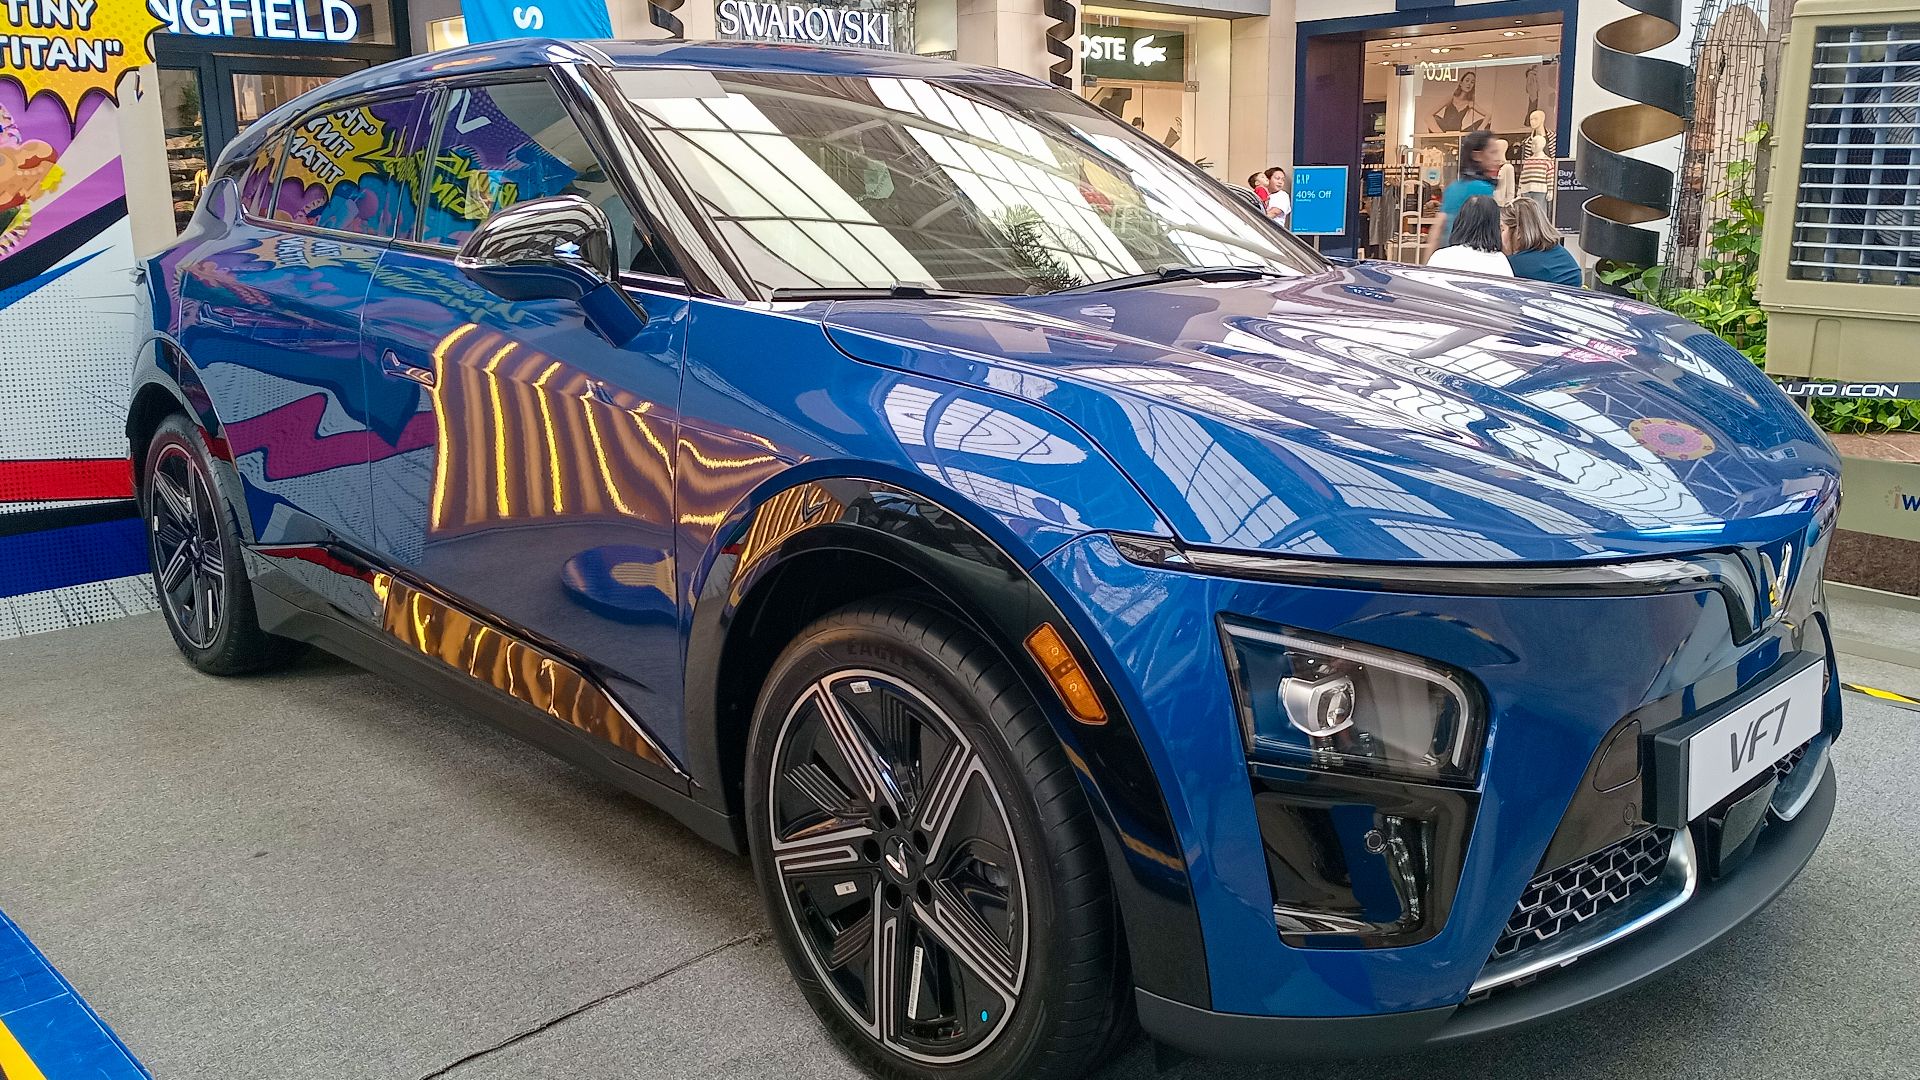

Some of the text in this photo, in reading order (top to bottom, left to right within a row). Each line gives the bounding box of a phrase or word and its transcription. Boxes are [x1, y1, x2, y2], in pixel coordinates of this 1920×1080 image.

[2, 0, 96, 28] TINY
[719, 0, 890, 46] SWAROVSKI
[1296, 173, 1310, 184] GAP
[1558, 169, 1574, 183] Buy
[1558, 178, 1572, 190] Get
[1296, 190, 1332, 199] 40% Off
